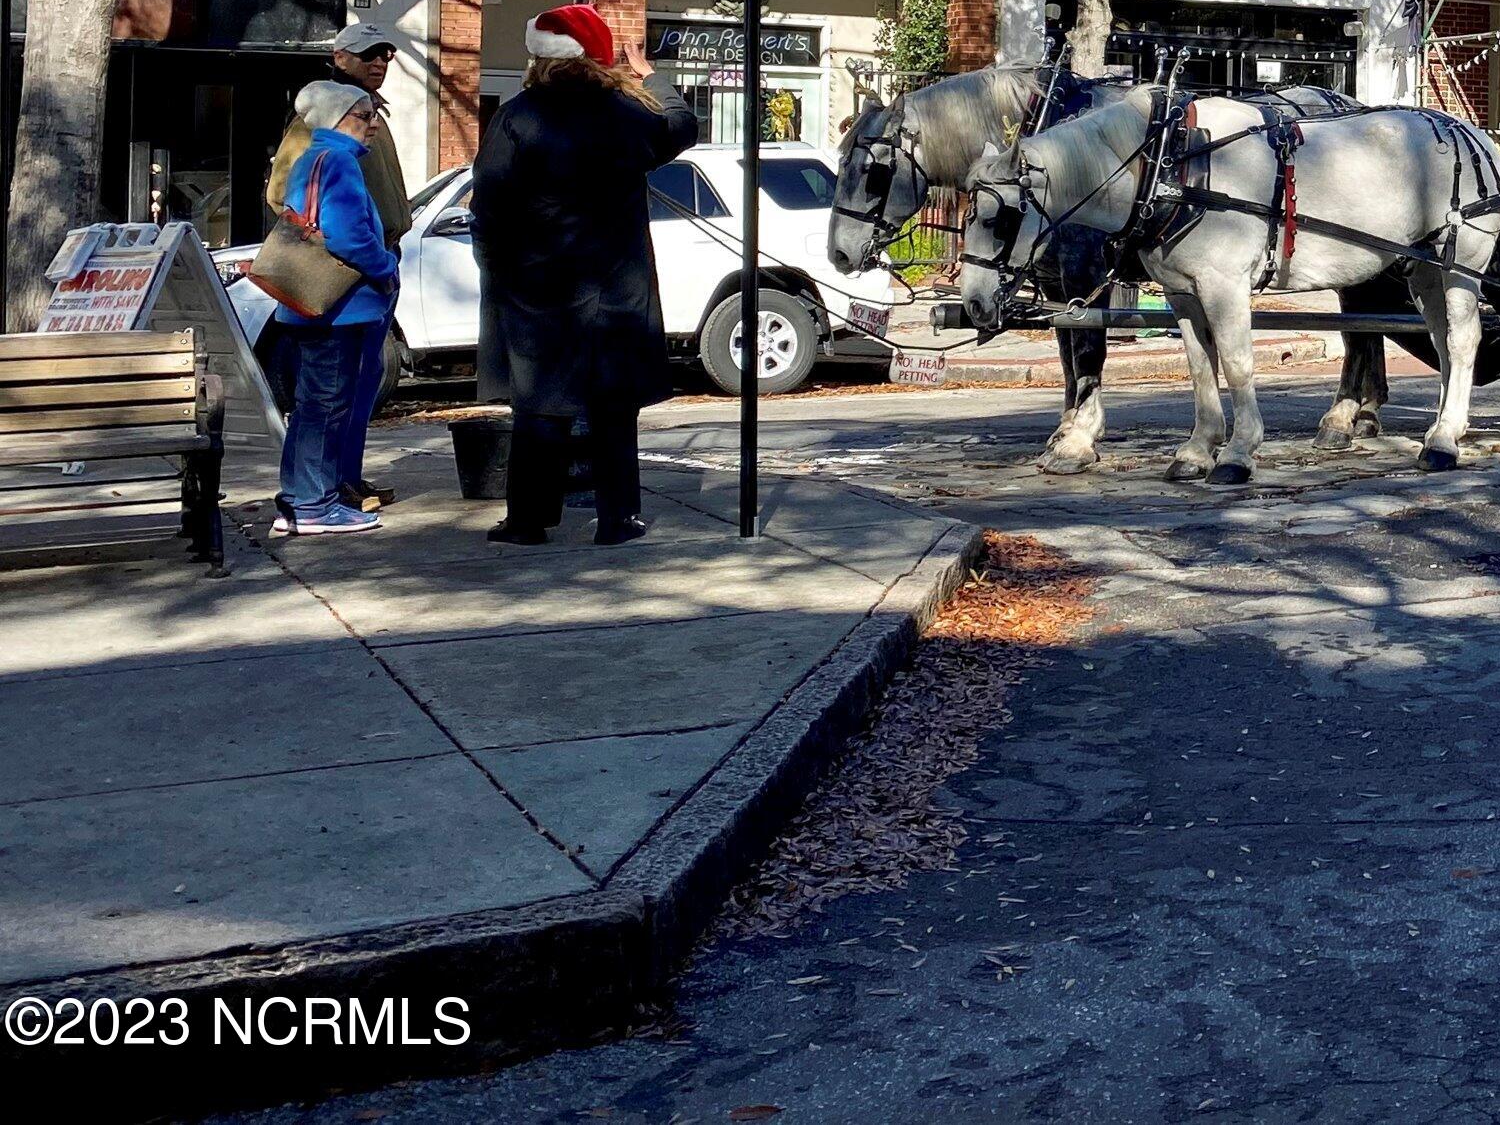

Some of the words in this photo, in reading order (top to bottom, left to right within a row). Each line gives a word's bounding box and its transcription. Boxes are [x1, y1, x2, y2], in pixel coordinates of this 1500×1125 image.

[652, 26, 711, 53] John
[718, 27, 809, 52] Roert's
[678, 46, 717, 61] HAIR
[724, 48, 784, 65] DEGN
[918, 357, 946, 370] HEAD
[898, 370, 938, 383] PETTING
